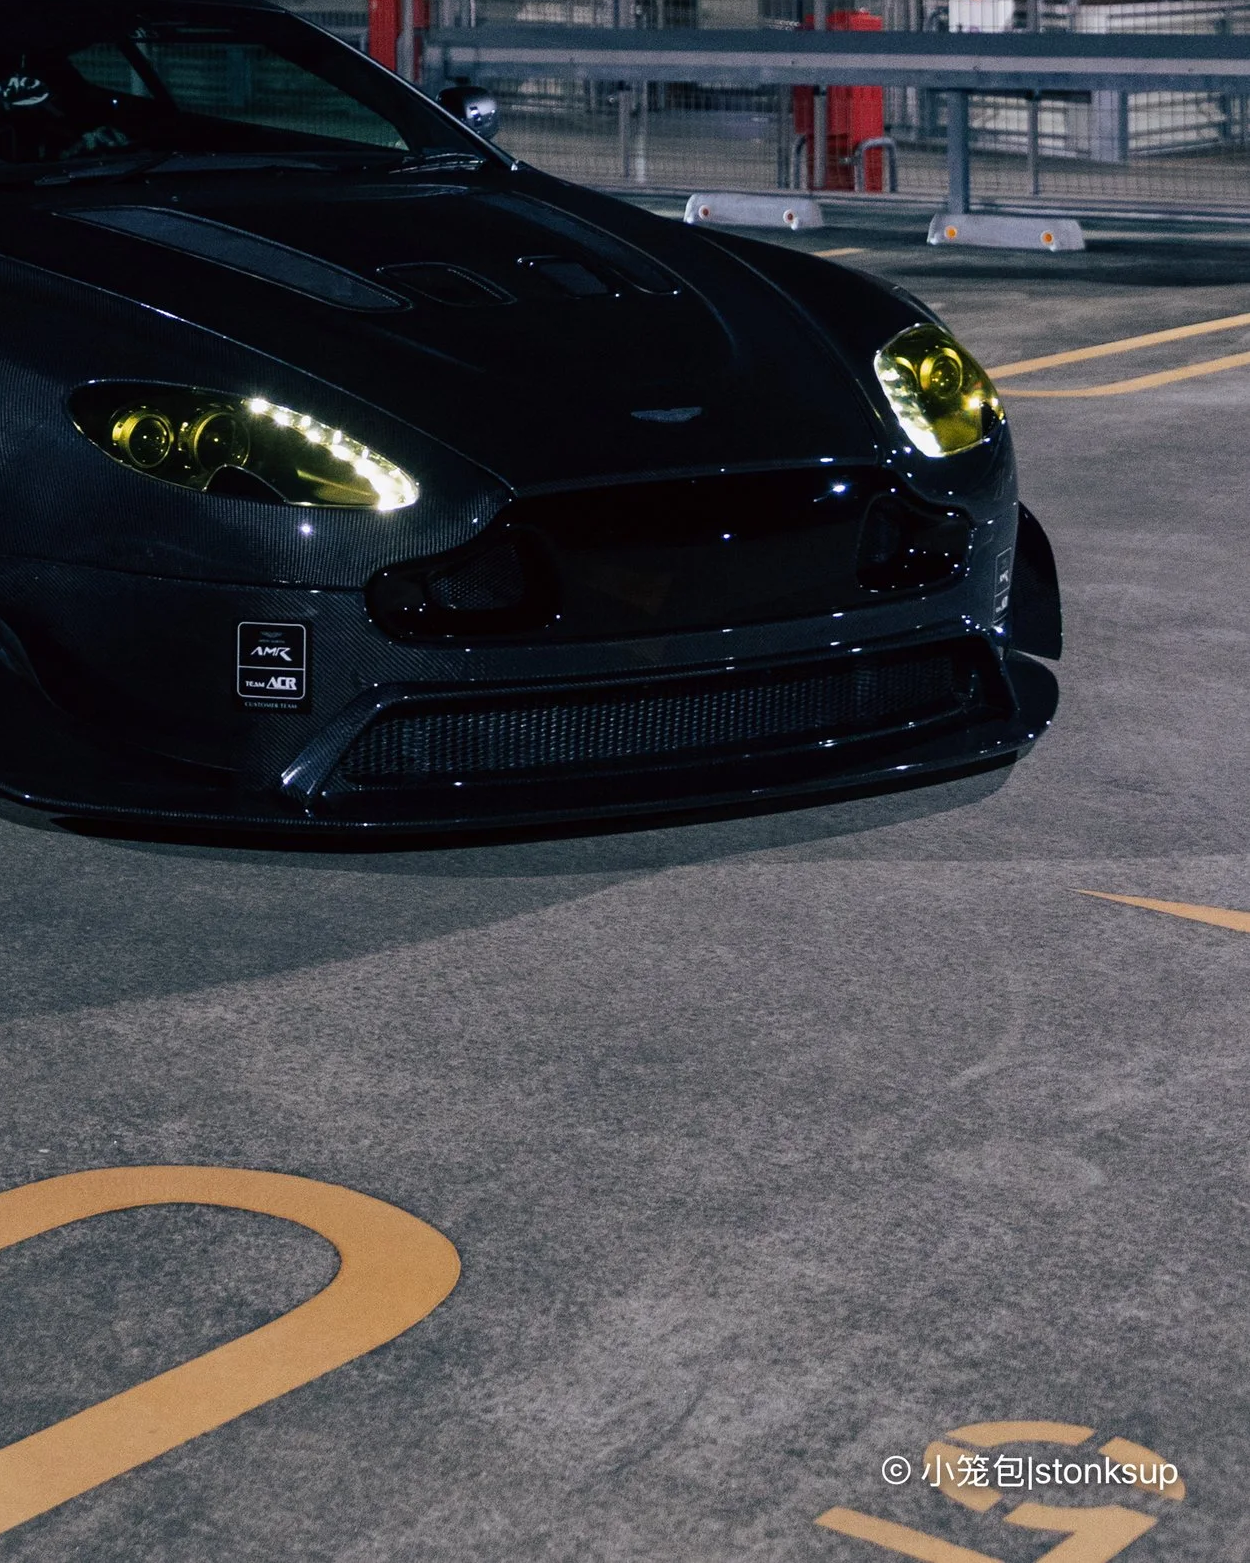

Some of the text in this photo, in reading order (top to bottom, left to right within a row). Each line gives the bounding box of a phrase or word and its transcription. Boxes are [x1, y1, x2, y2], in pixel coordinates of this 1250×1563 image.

[250, 646, 292, 661] AMR
[245, 676, 297, 690] TEAM ACR
